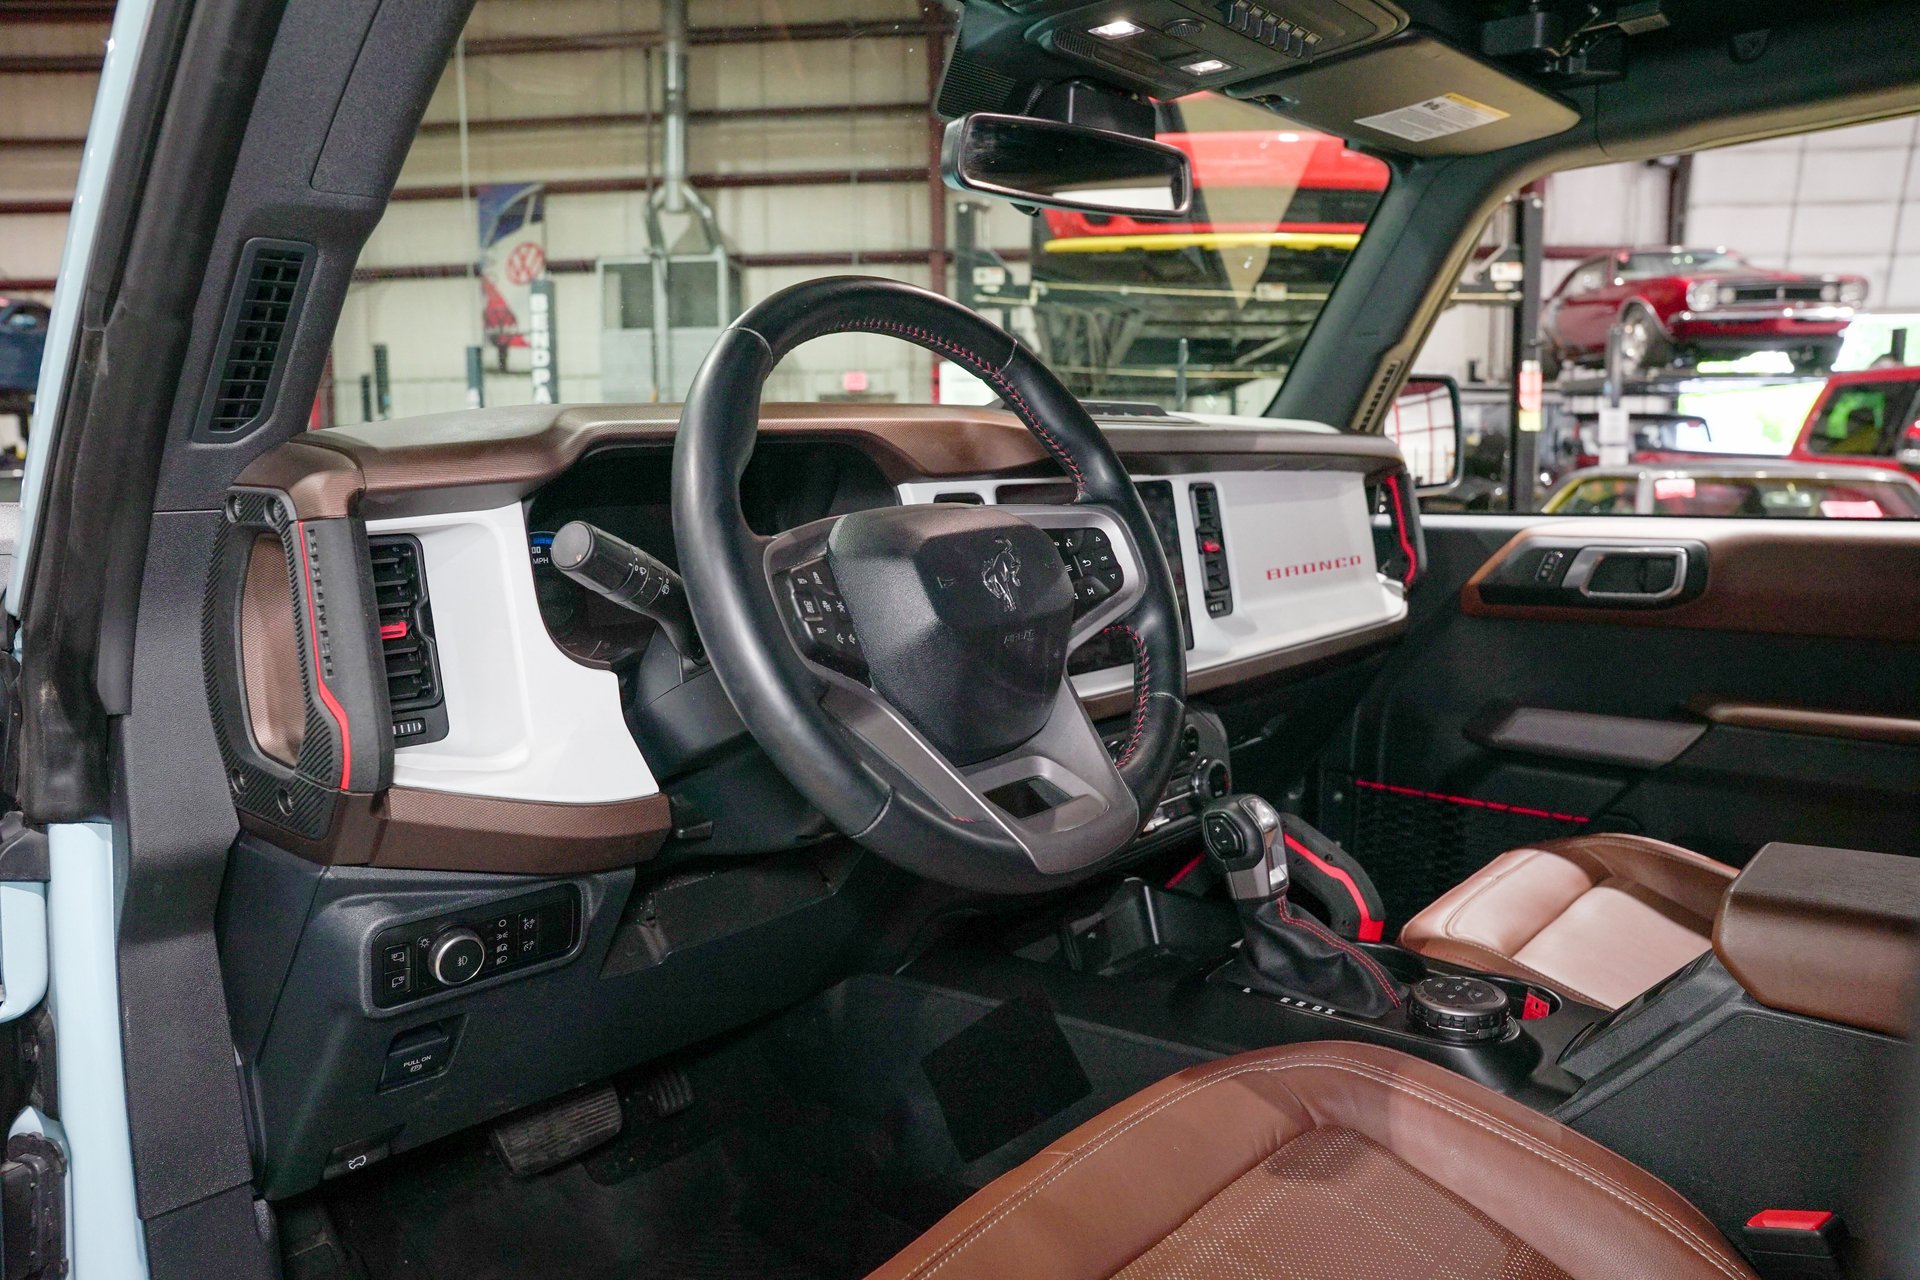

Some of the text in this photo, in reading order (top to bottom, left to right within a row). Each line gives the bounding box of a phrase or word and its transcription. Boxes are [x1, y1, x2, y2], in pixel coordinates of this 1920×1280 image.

[1266, 555, 1361, 581] BRONCO
[403, 1054, 431, 1068] PULL ON
